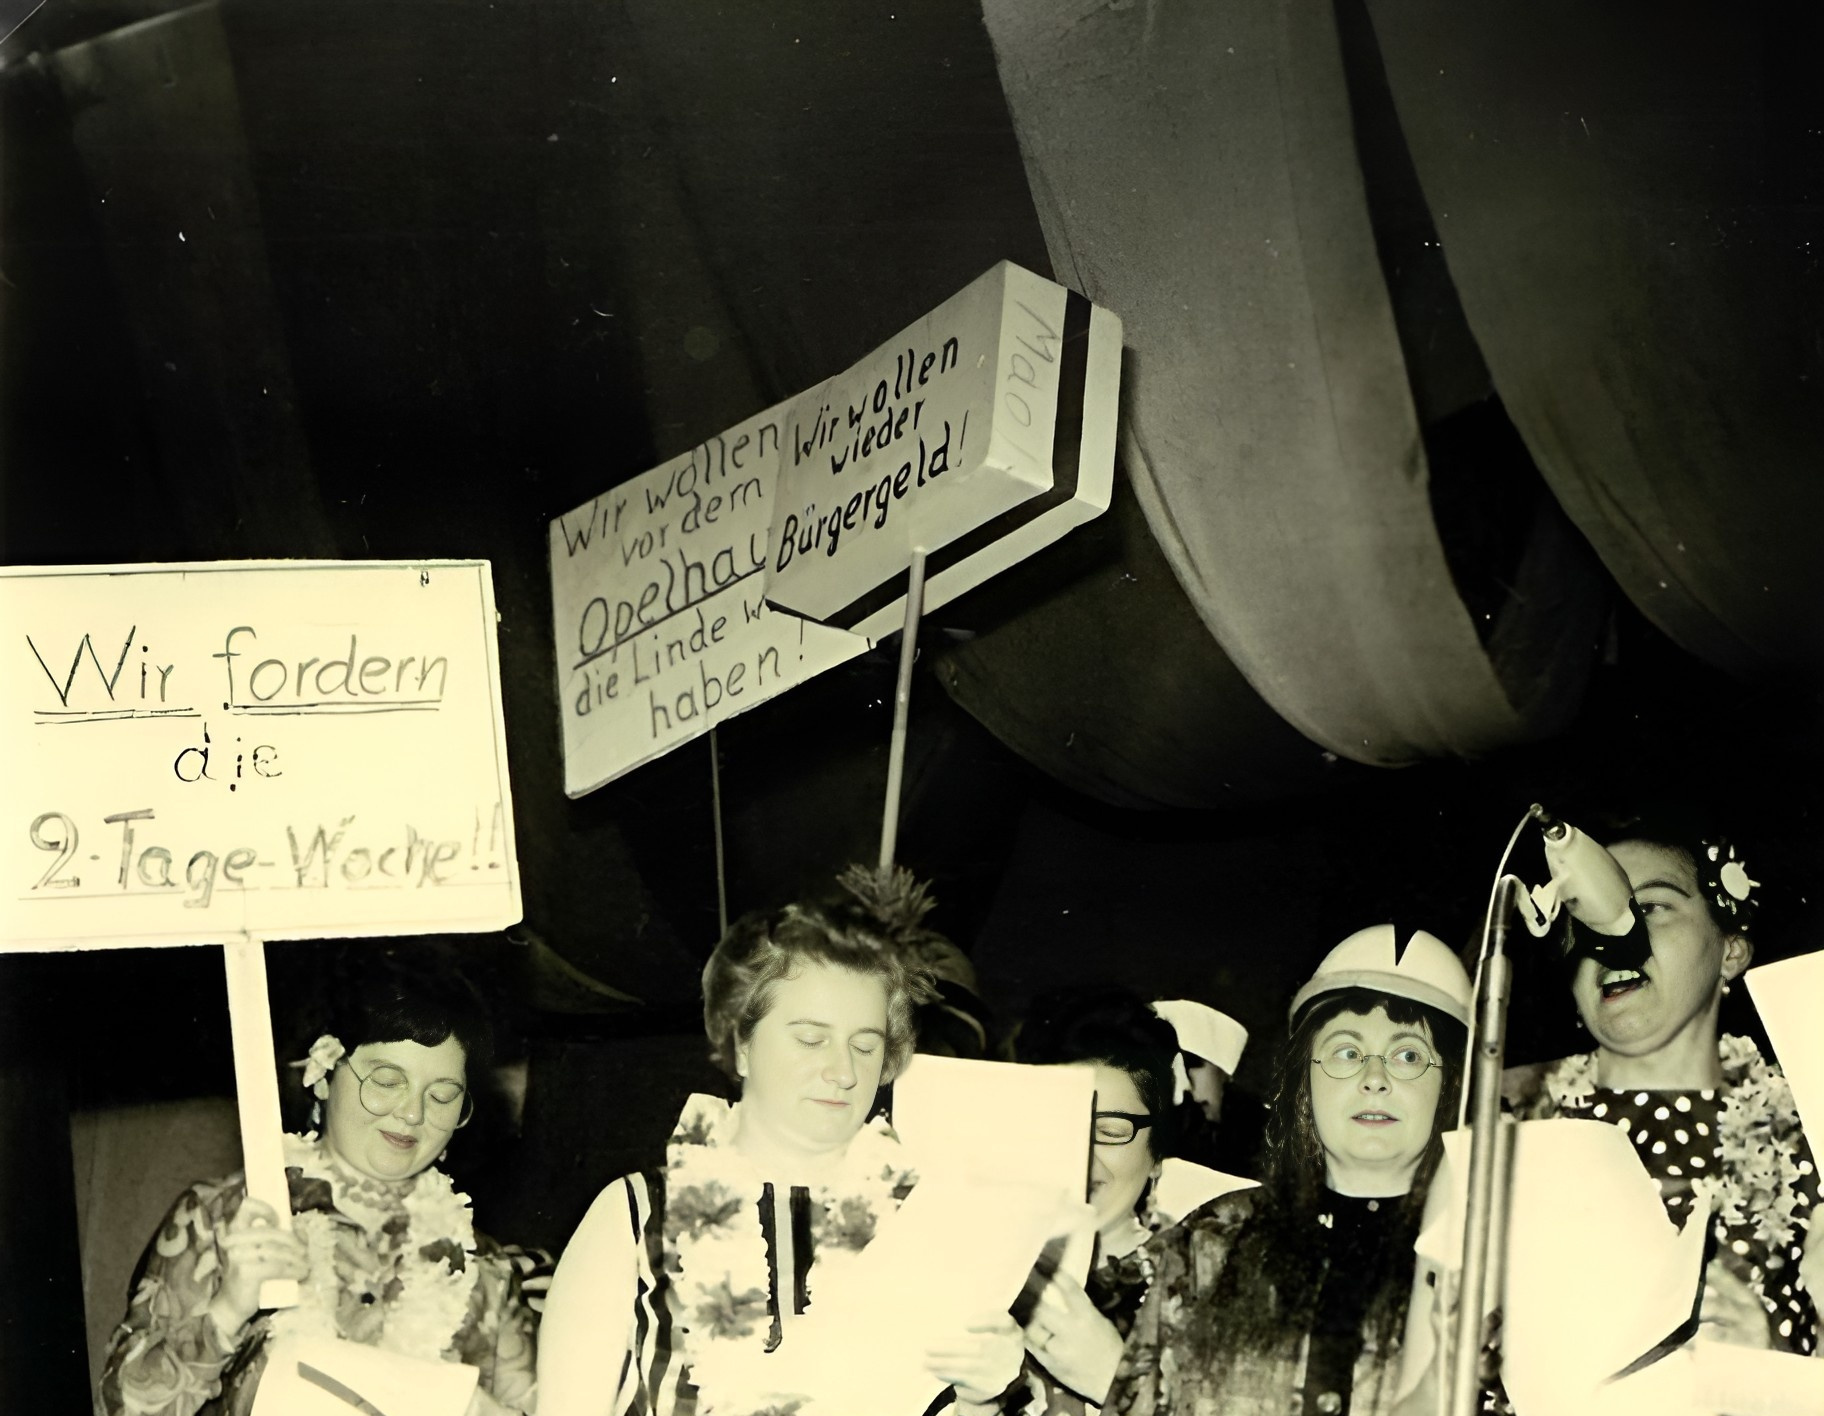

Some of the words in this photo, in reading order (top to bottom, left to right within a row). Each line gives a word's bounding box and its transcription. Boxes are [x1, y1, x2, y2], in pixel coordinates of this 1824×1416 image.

[795, 406, 838, 465] Wir
[847, 336, 960, 427] wollen
[830, 396, 926, 476] wieder
[560, 496, 626, 557] Wir
[645, 422, 780, 515] wollen
[776, 409, 970, 573] Bürgergeld!
[620, 517, 668, 568] vor
[26, 624, 175, 707] Wir
[212, 625, 448, 702] fordern
[575, 665, 620, 718] die
[633, 605, 727, 684] Linde
[173, 721, 283, 787] die
